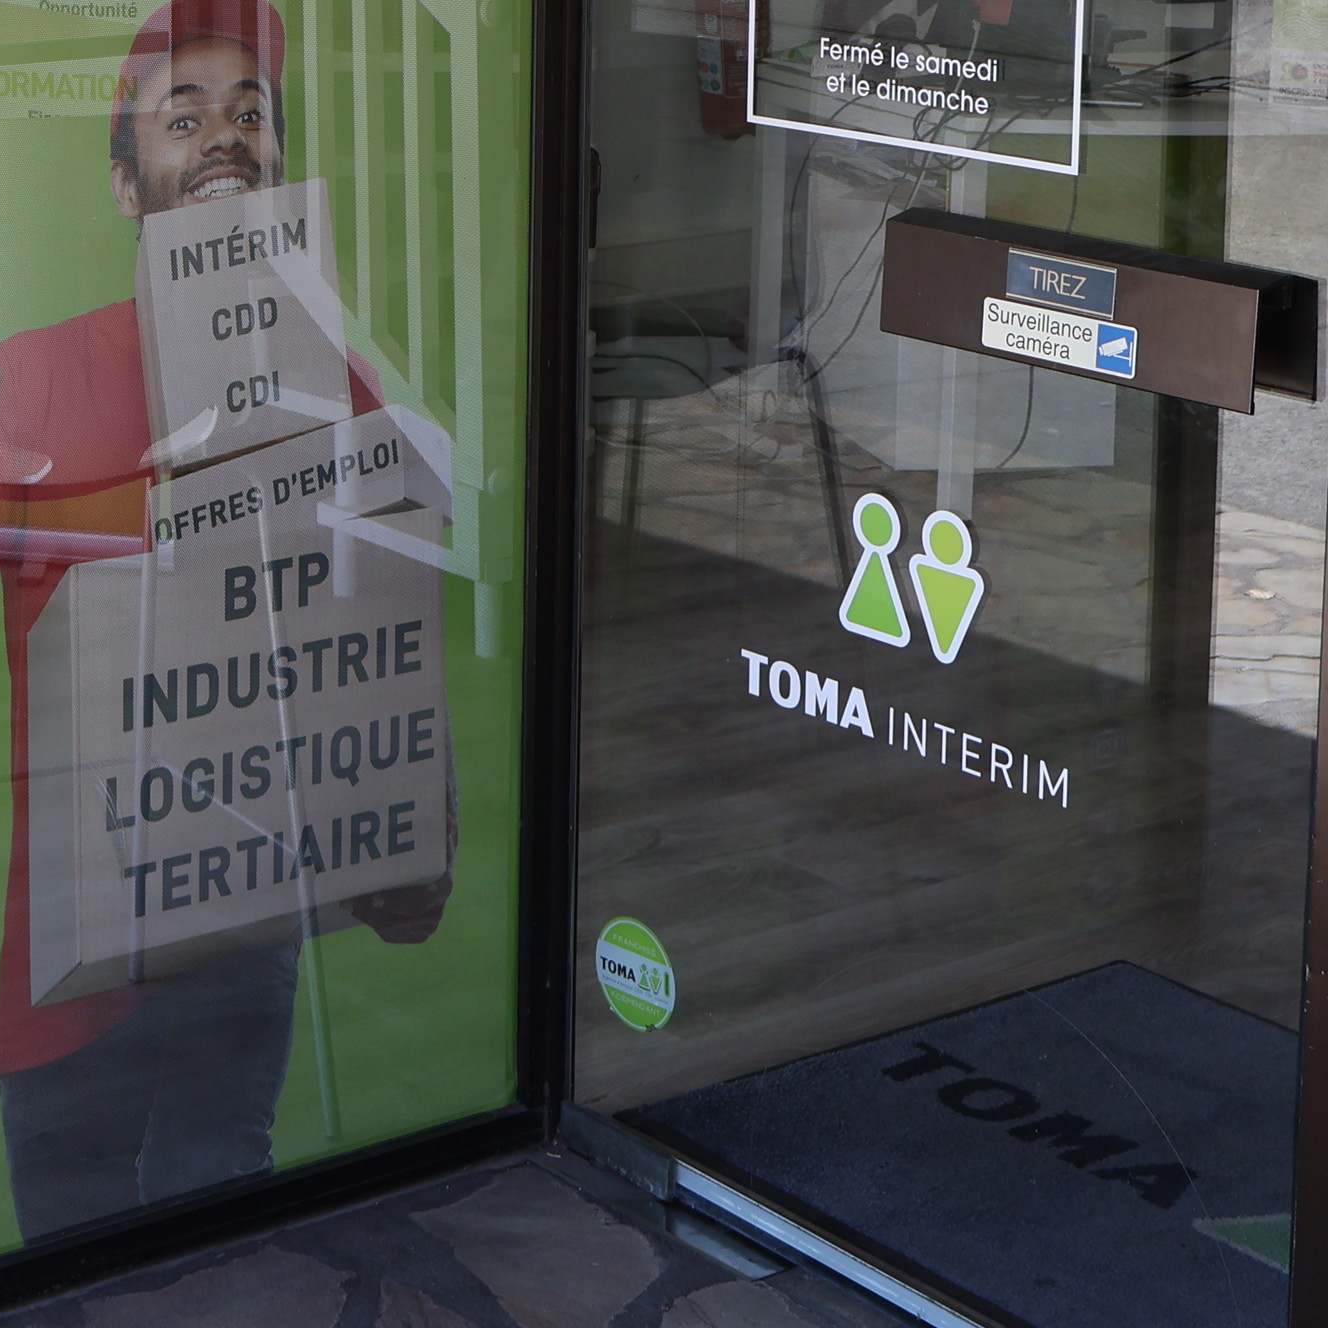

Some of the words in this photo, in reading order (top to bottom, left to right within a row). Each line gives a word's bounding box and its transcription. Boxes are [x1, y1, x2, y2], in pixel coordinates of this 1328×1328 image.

[820, 37, 884, 66] Fermé
[891, 45, 909, 70] le
[916, 54, 998, 83] samedi
[826, 72, 846, 93] et
[851, 74, 870, 97] le
[876, 79, 989, 115] dimanche
[170, 218, 307, 281] INTÉRIM
[1029, 266, 1087, 300] TIREZ
[212, 296, 278, 341] CDD
[987, 302, 1092, 342] Surveillance
[1006, 333, 1070, 360] caméra
[226, 370, 280, 413] CDI
[155, 486, 263, 545] OFFRES
[273, 439, 400, 506] D'EMPLOI
[224, 551, 330, 622] BTP
[122, 619, 423, 732] INDUSTRIE
[741, 648, 874, 739] TOMA
[888, 707, 1069, 808] INTERIM
[105, 708, 435, 832] LOGISTIQUE
[124, 800, 416, 918] TERTIAIRE
[600, 956, 636, 983] TOMA
[881, 1041, 1198, 1210] TOMA
